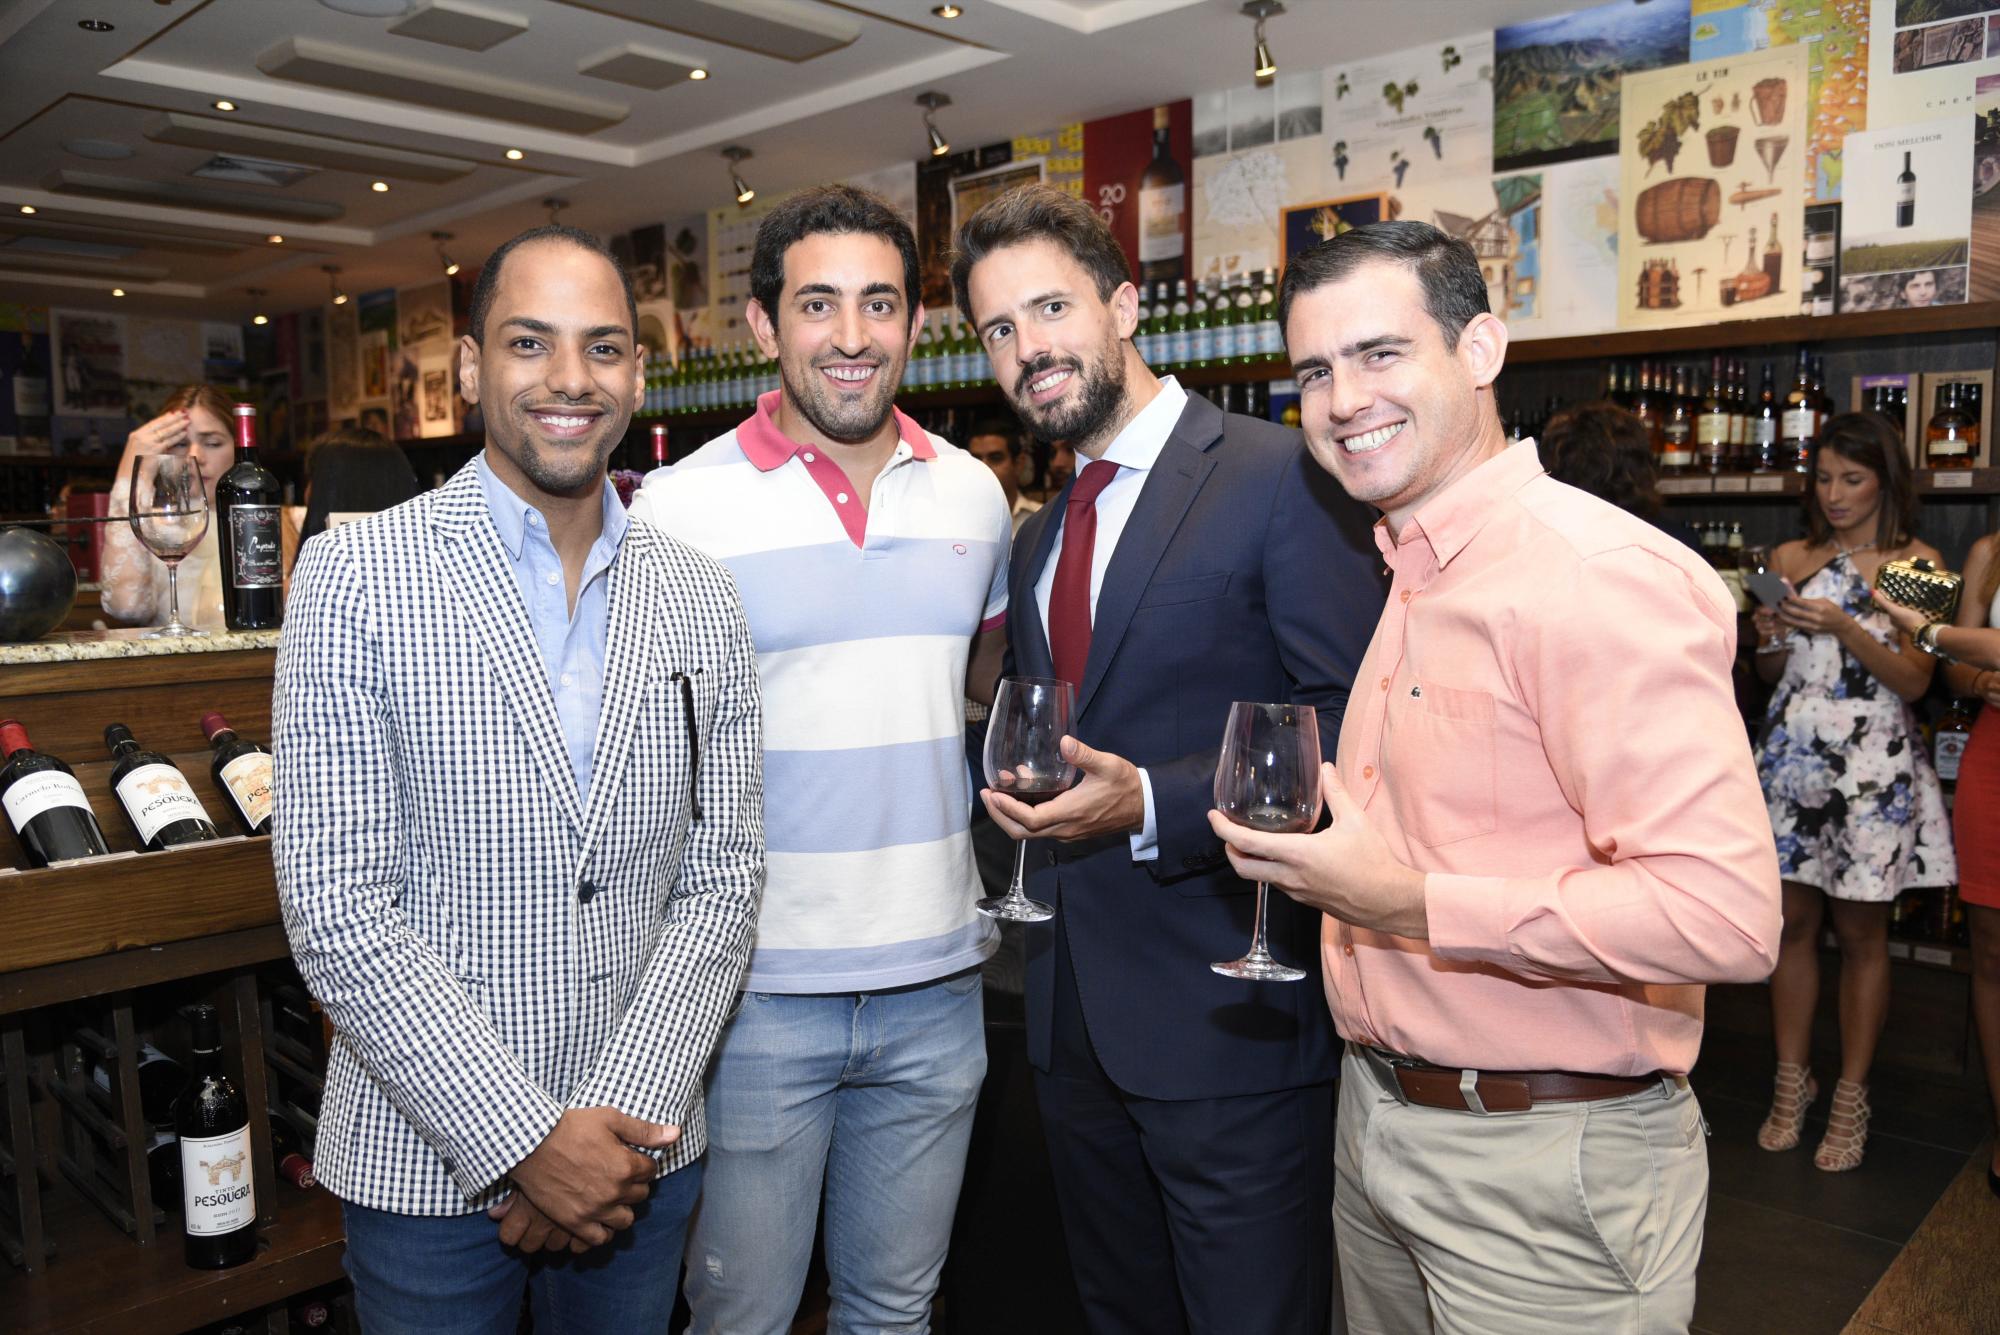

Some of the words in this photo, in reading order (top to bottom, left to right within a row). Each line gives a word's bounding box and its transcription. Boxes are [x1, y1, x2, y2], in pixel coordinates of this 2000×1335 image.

[1897, 133, 1943, 147] MELCHOR
[1099, 183, 1126, 206] 20
[194, 1183, 251, 1208] PESQUERA
[215, 1185, 236, 1195] TINTO
